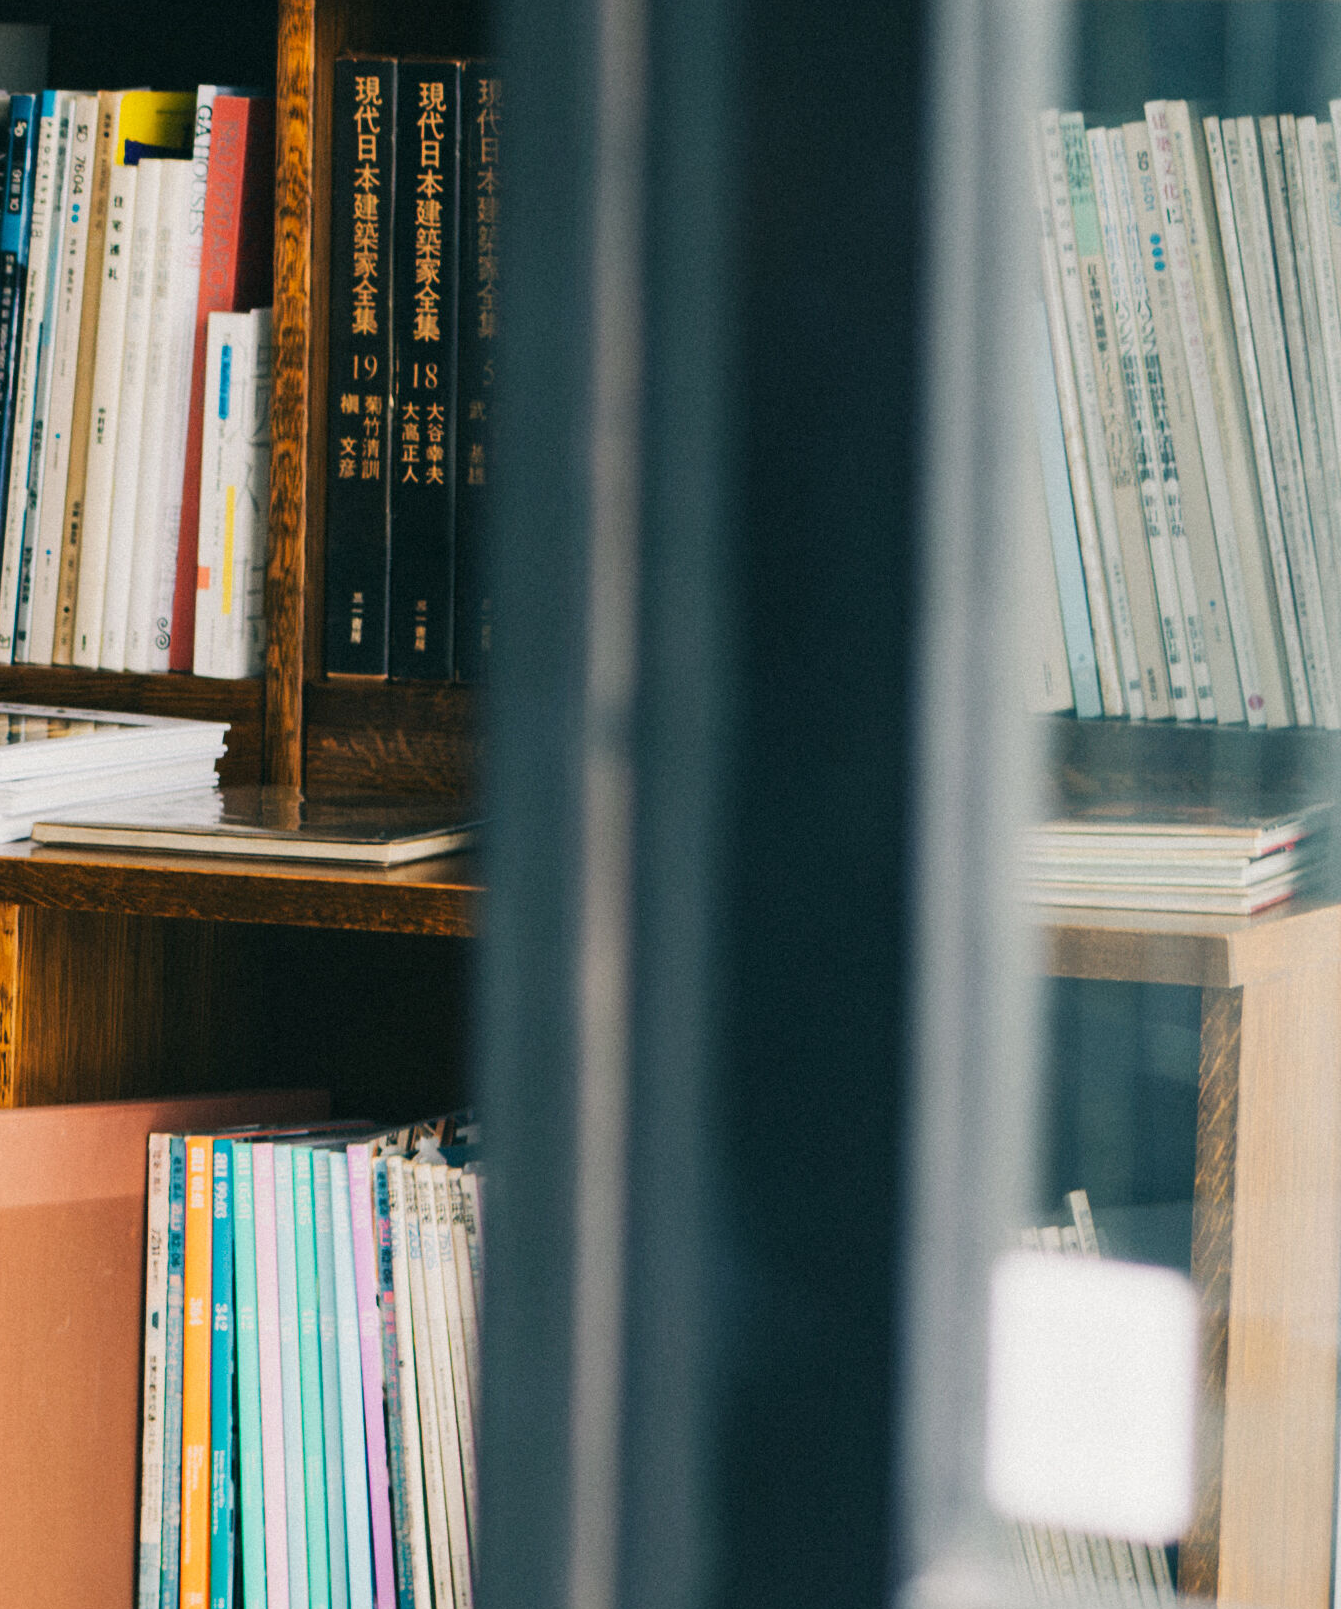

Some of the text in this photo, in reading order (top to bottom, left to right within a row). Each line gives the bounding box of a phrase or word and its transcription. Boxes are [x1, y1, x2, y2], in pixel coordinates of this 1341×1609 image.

[72, 124, 89, 196] SD 7604
[188, 104, 212, 235] GA HOUSES
[352, 76, 382, 381] 現代日本建築家全集 19
[412, 81, 445, 390] 現代日本建築家全集 18
[402, 402, 420, 484] 大高正人
[214, 1181, 227, 1331] 99:03 342
